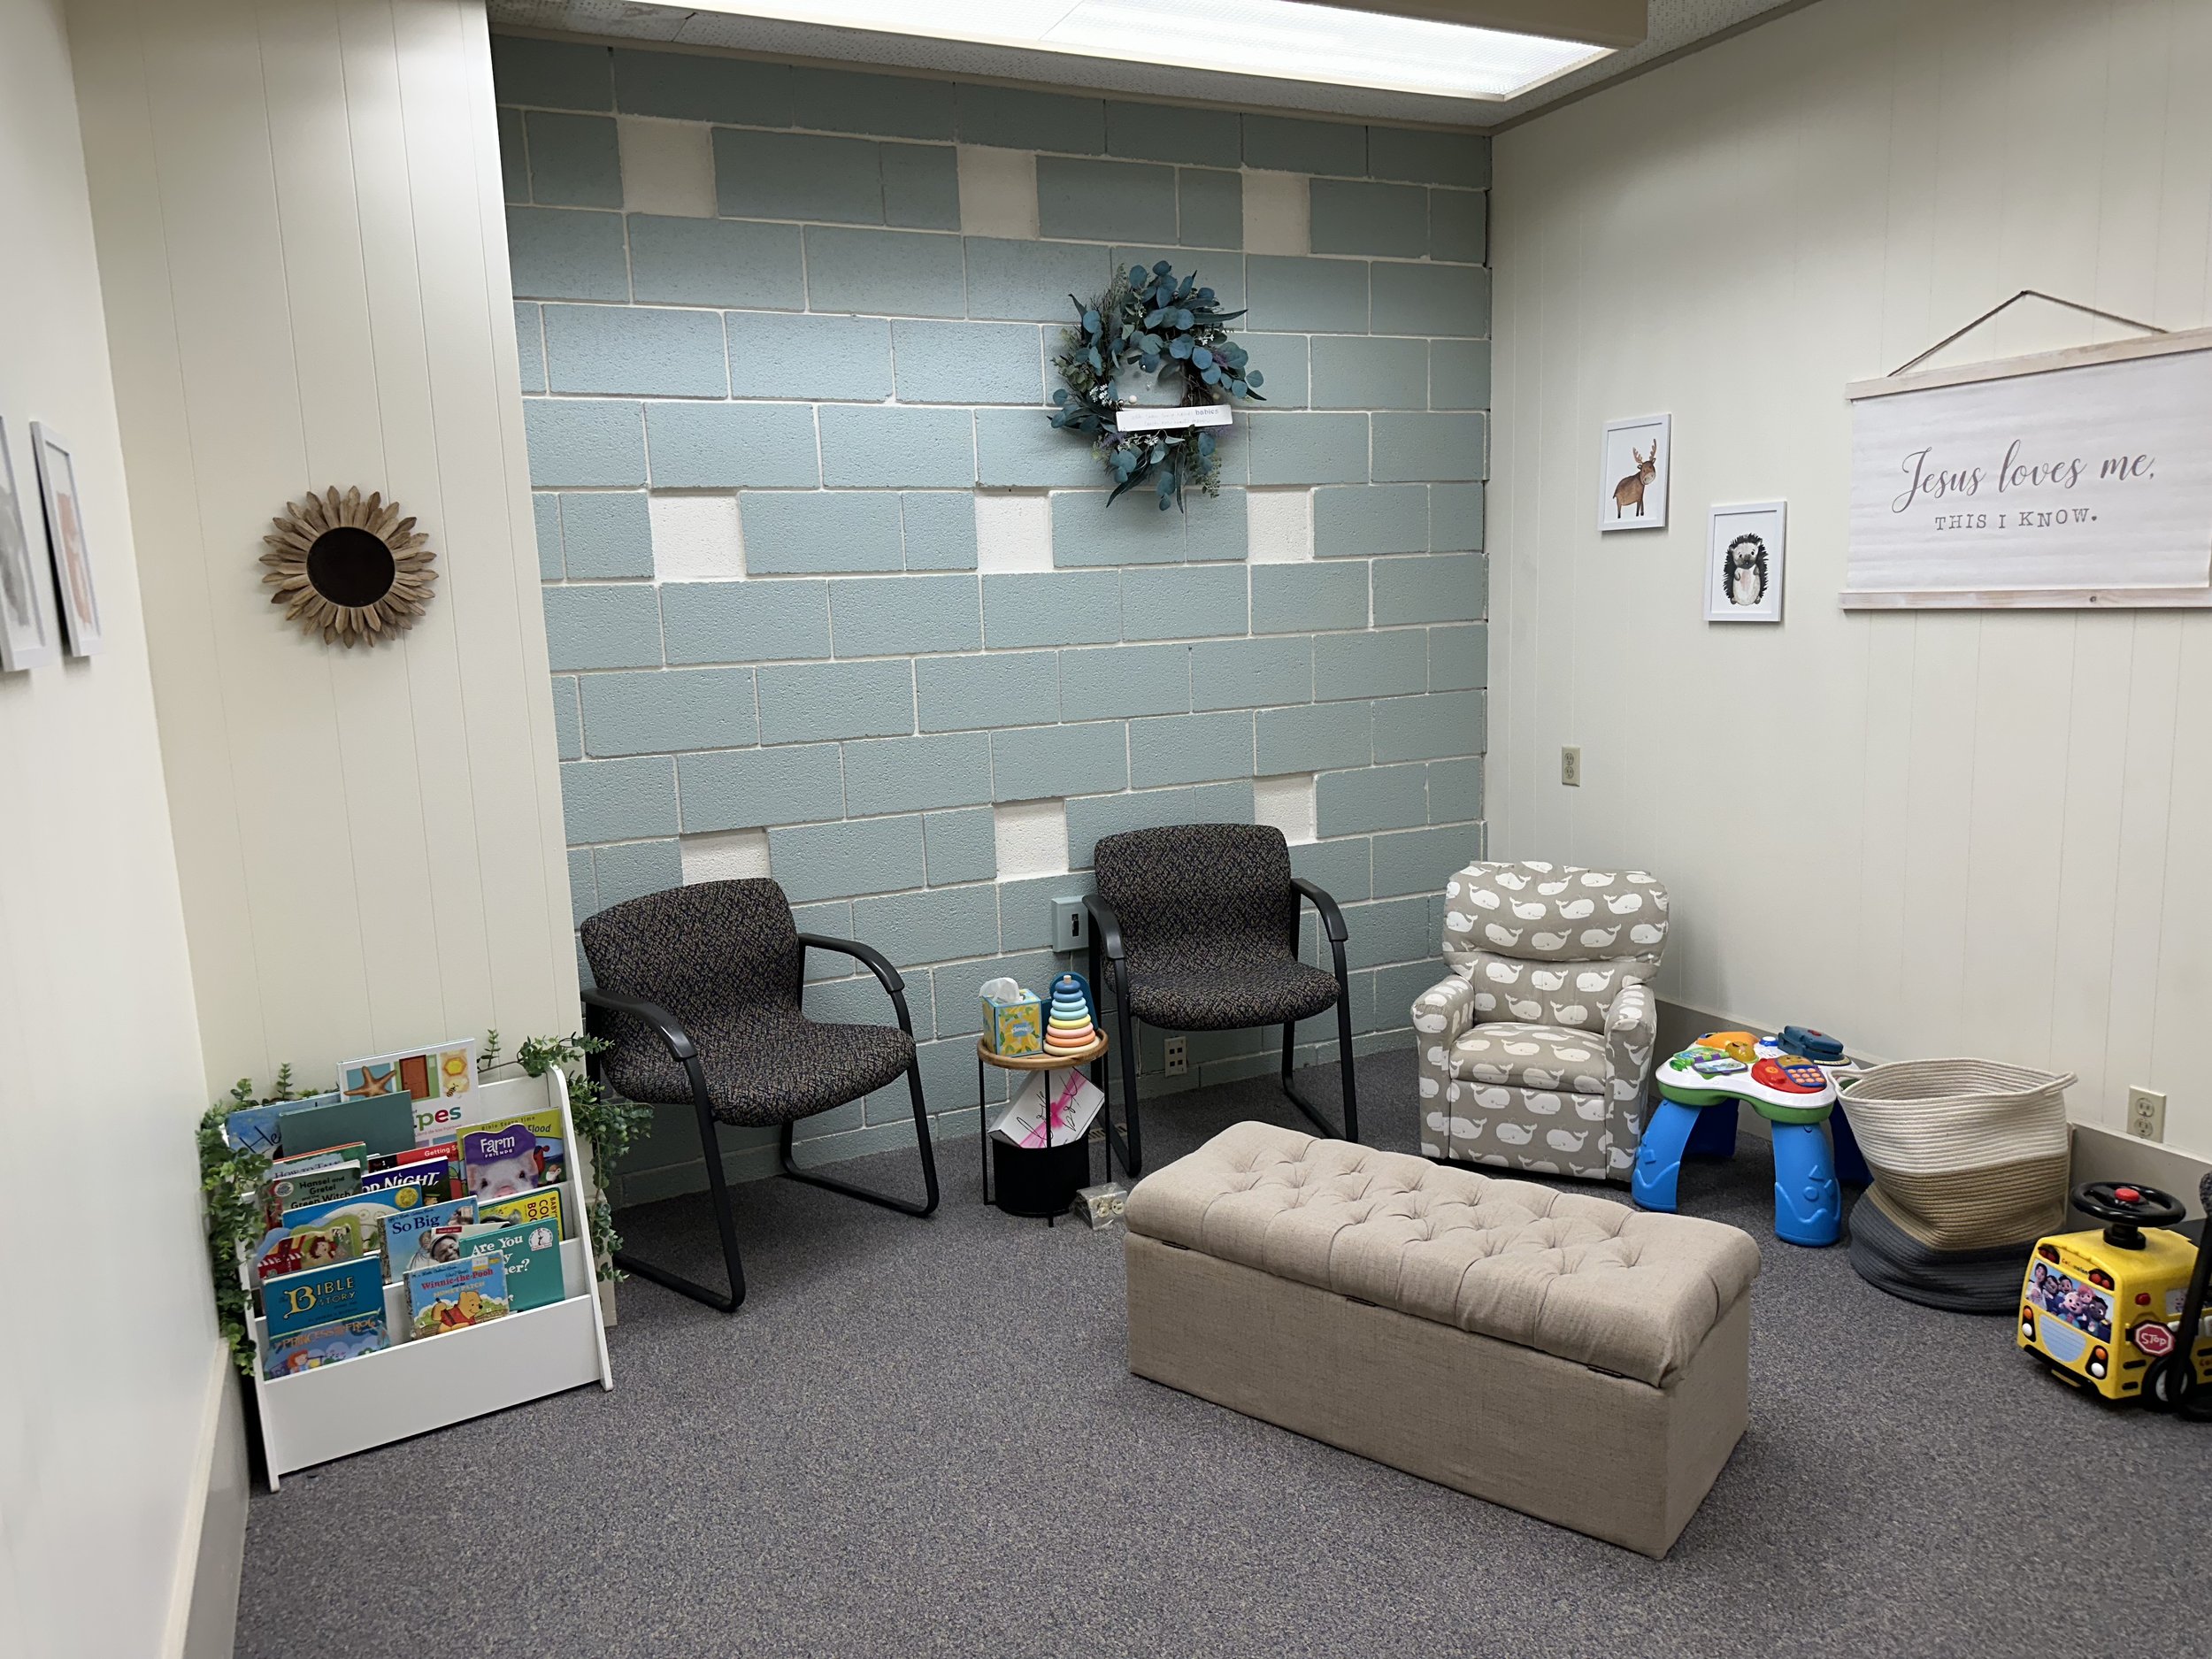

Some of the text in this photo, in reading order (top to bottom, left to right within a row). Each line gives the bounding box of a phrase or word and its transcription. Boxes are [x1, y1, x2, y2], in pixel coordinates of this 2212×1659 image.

[1892, 439, 2155, 513] Jesus loves me,
[1934, 513, 1987, 531] THIS
[1998, 514, 2007, 529] I
[425, 1145, 450, 1157] Getting
[480, 1135, 515, 1154] Farm
[299, 1175, 345, 1190] Hansel and
[310, 1185, 336, 1194] Gretel
[290, 1189, 351, 1210] Green Witch
[392, 1221, 412, 1235] So
[414, 1215, 441, 1229] Big
[471, 1244, 495, 1257] Are
[500, 1235, 524, 1249] You
[283, 1277, 354, 1319] BIBLE
[319, 1291, 355, 1306] STORY
